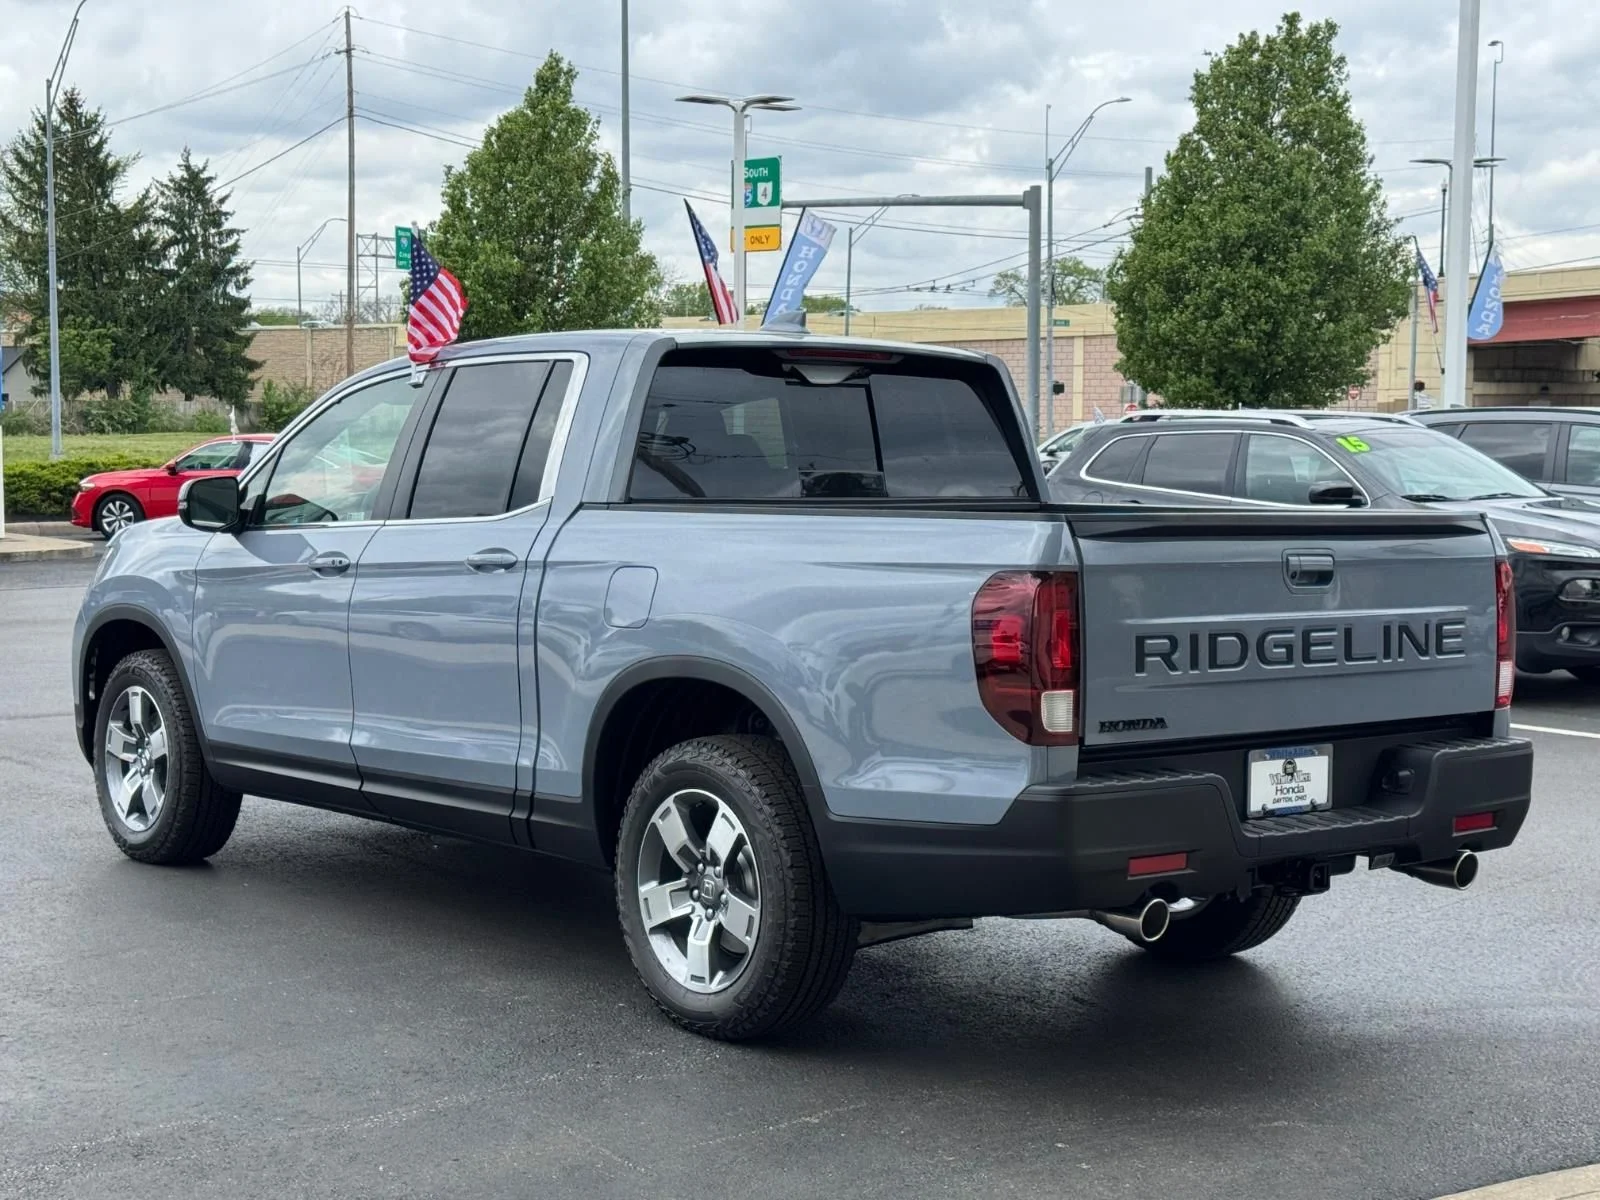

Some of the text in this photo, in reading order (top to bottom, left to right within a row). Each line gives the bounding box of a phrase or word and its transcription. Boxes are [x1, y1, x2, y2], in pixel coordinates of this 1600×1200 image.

[744, 167, 769, 178] SOUTH
[761, 186, 768, 200] 4
[750, 234, 770, 245] ONLY
[1335, 434, 1370, 453] 15
[1135, 616, 1467, 677] RIDGELINE
[1098, 717, 1168, 734] HONDA
[1275, 784, 1305, 796] Honda
